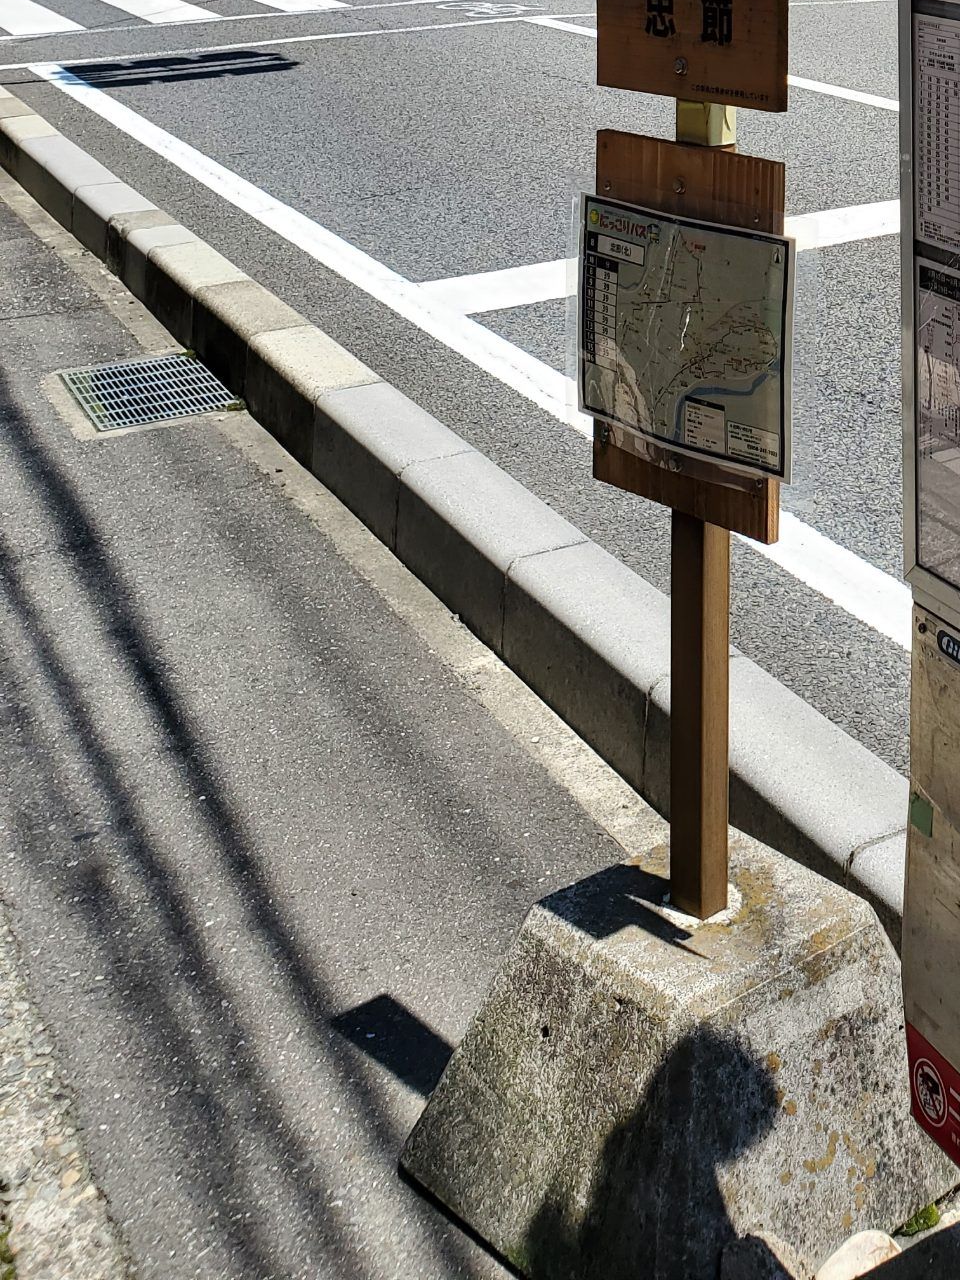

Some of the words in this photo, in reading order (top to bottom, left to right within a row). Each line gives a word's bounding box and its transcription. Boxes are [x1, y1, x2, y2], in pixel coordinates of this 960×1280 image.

[600, 213, 647, 239] にっこりバス
